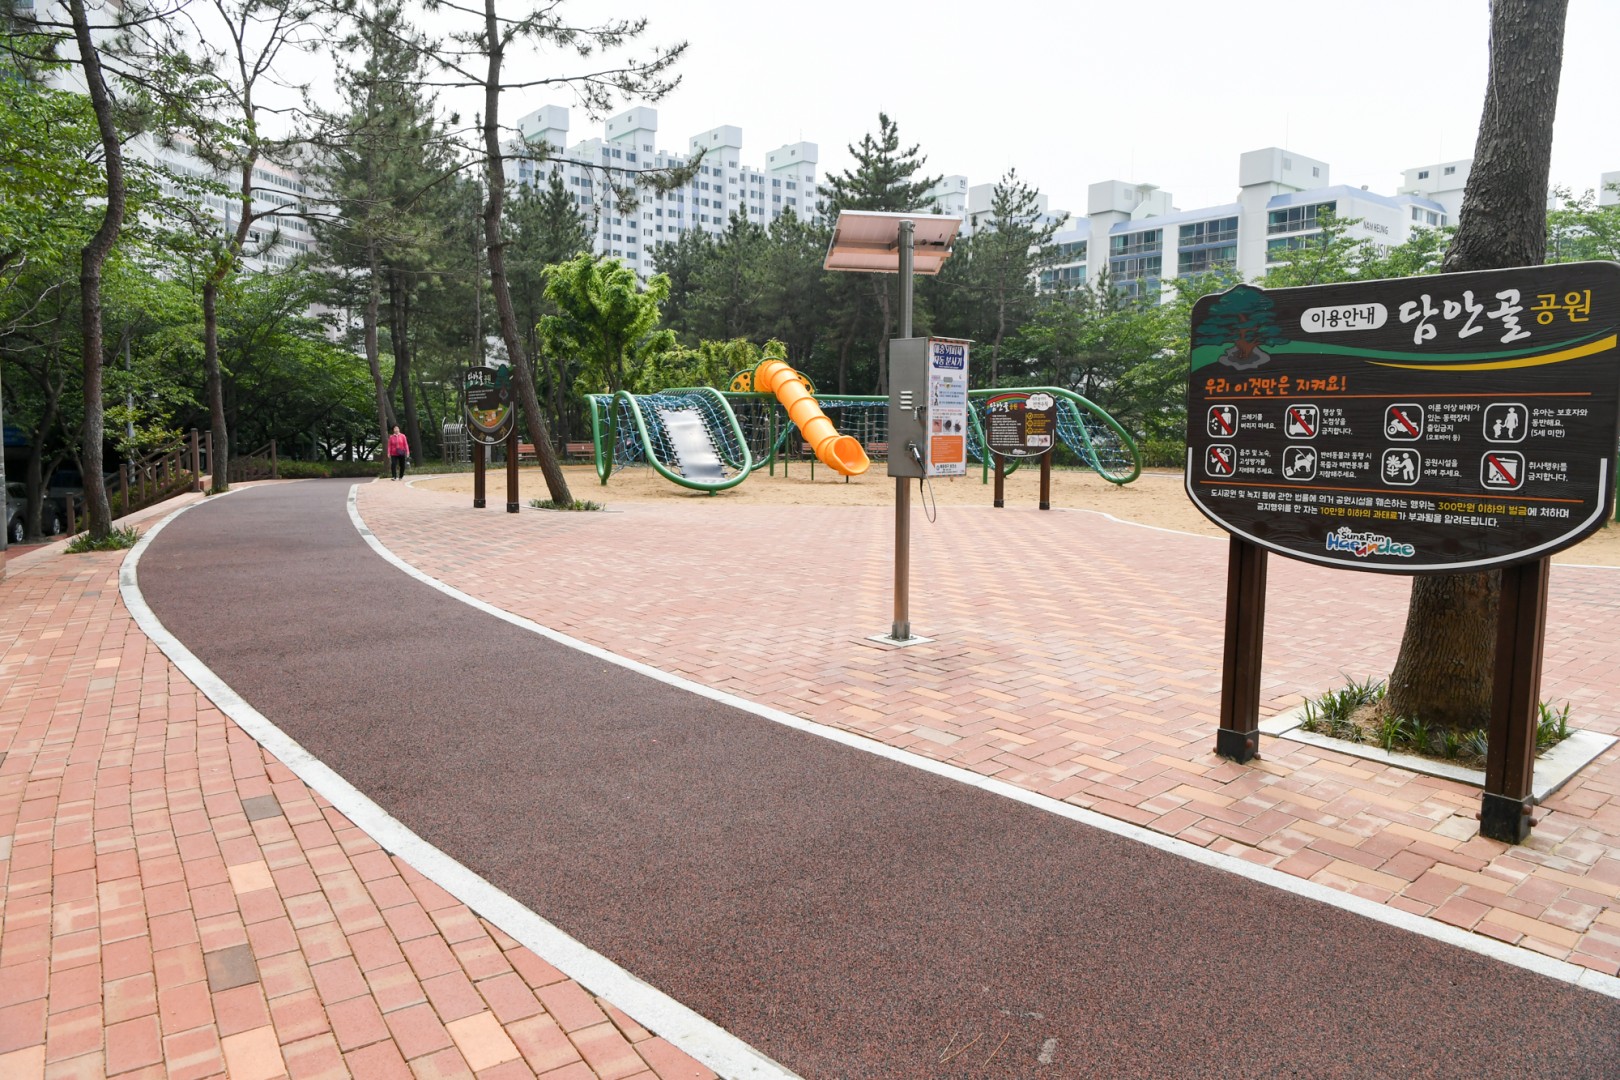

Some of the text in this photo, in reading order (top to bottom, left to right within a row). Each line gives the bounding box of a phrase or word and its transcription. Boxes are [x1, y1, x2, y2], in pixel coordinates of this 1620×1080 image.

[1311, 289, 1592, 345] 이용안내 담안골 공원
[1204, 375, 1347, 396] 우리 이것만은 지켜요!
[1322, 408, 1343, 416] 행상 및
[1459, 404, 1480, 412] 바퀴가
[1240, 413, 1263, 421] 쓰레기를
[1427, 414, 1470, 422] 있는 동력장치
[1240, 422, 1276, 430] 버리지 마세요.
[1322, 418, 1346, 426] 노점상을
[1532, 419, 1564, 427] 동반해요.
[1321, 427, 1353, 436] 금지합니다.
[1427, 424, 1454, 432] 출입금지
[1531, 429, 1565, 437] (5세 미만)
[1239, 449, 1251, 457] 음주
[1252, 449, 1257, 457] 및
[1320, 452, 1372, 460] 반려동물과 동행 시
[1239, 458, 1266, 466] 고성방가를
[1339, 462, 1370, 470] 배변봉투를
[1424, 459, 1458, 467] 공원시설을
[1528, 462, 1567, 471] 취사행위를
[1256, 467, 1274, 475] 주세요.
[1319, 470, 1357, 479] 지참해주세요.
[1439, 469, 1462, 477] 주세요.
[1528, 472, 1568, 481] 금지합니다.
[1211, 489, 1569, 519] 도시공원 및 녹지 등에 관한 법률에 의거 공원시설을 훼손하는 행위는 300만원 이하의 벌금에 처하며
[1257, 502, 1500, 528] 금지행위를 한 자는 10만원 이하의 과태료가 부과됨을 알려드립니다.
[1341, 532, 1384, 542] Sun&Fun
